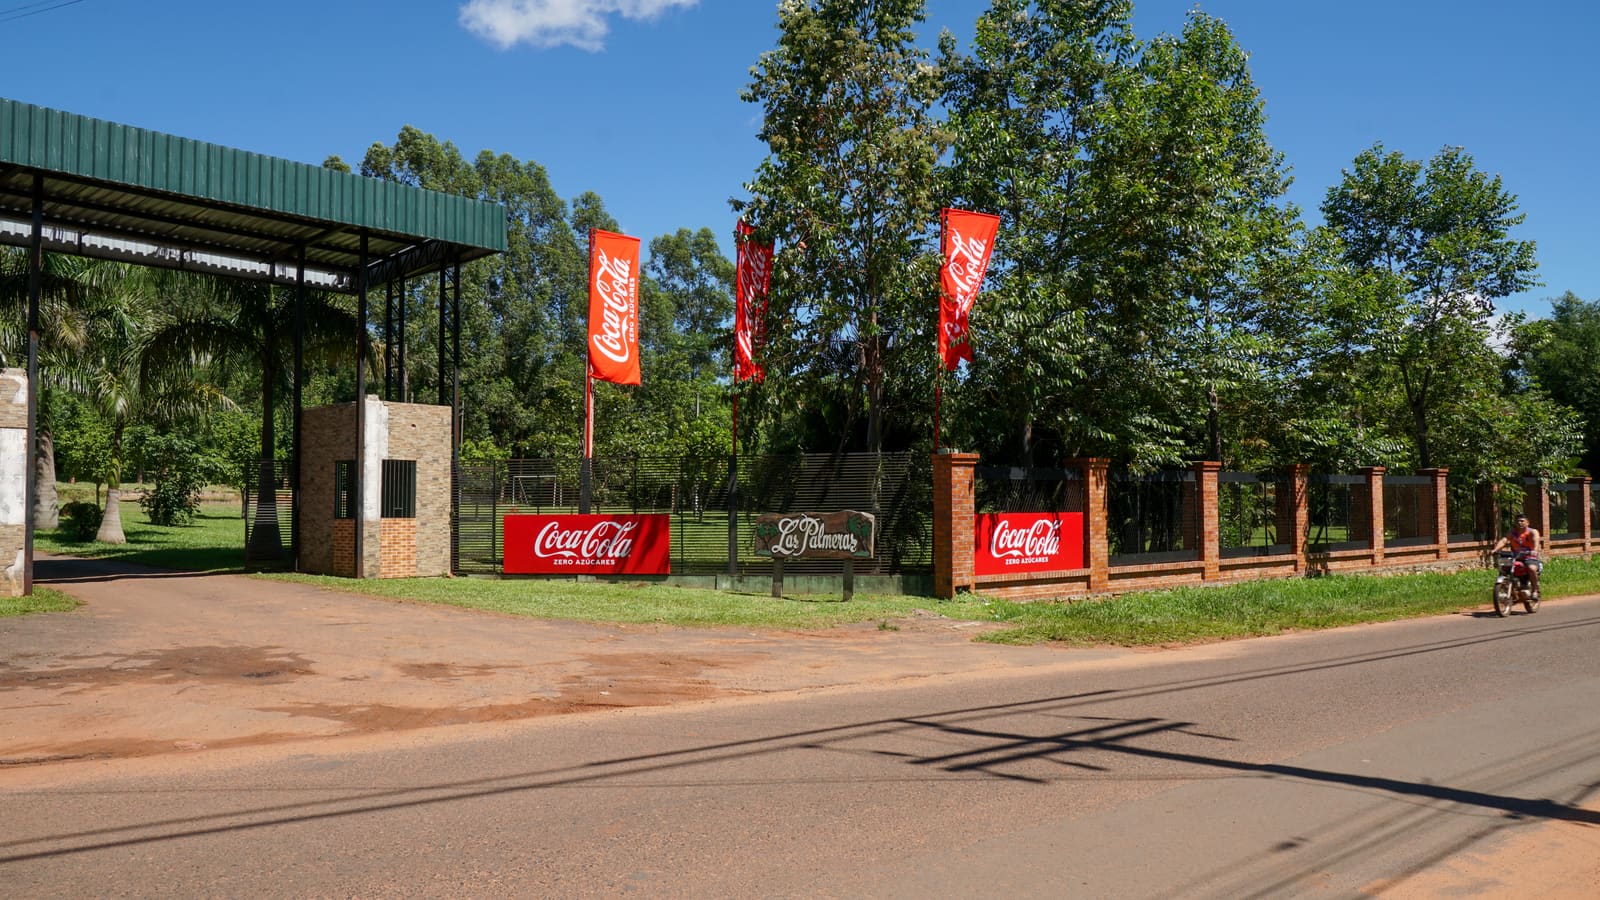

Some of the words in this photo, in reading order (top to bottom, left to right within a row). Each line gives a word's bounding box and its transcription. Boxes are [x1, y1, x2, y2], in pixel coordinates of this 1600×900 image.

[771, 518, 801, 555] Las
[793, 513, 858, 556] Palmeras
[575, 557, 615, 566] AZÚCARES
